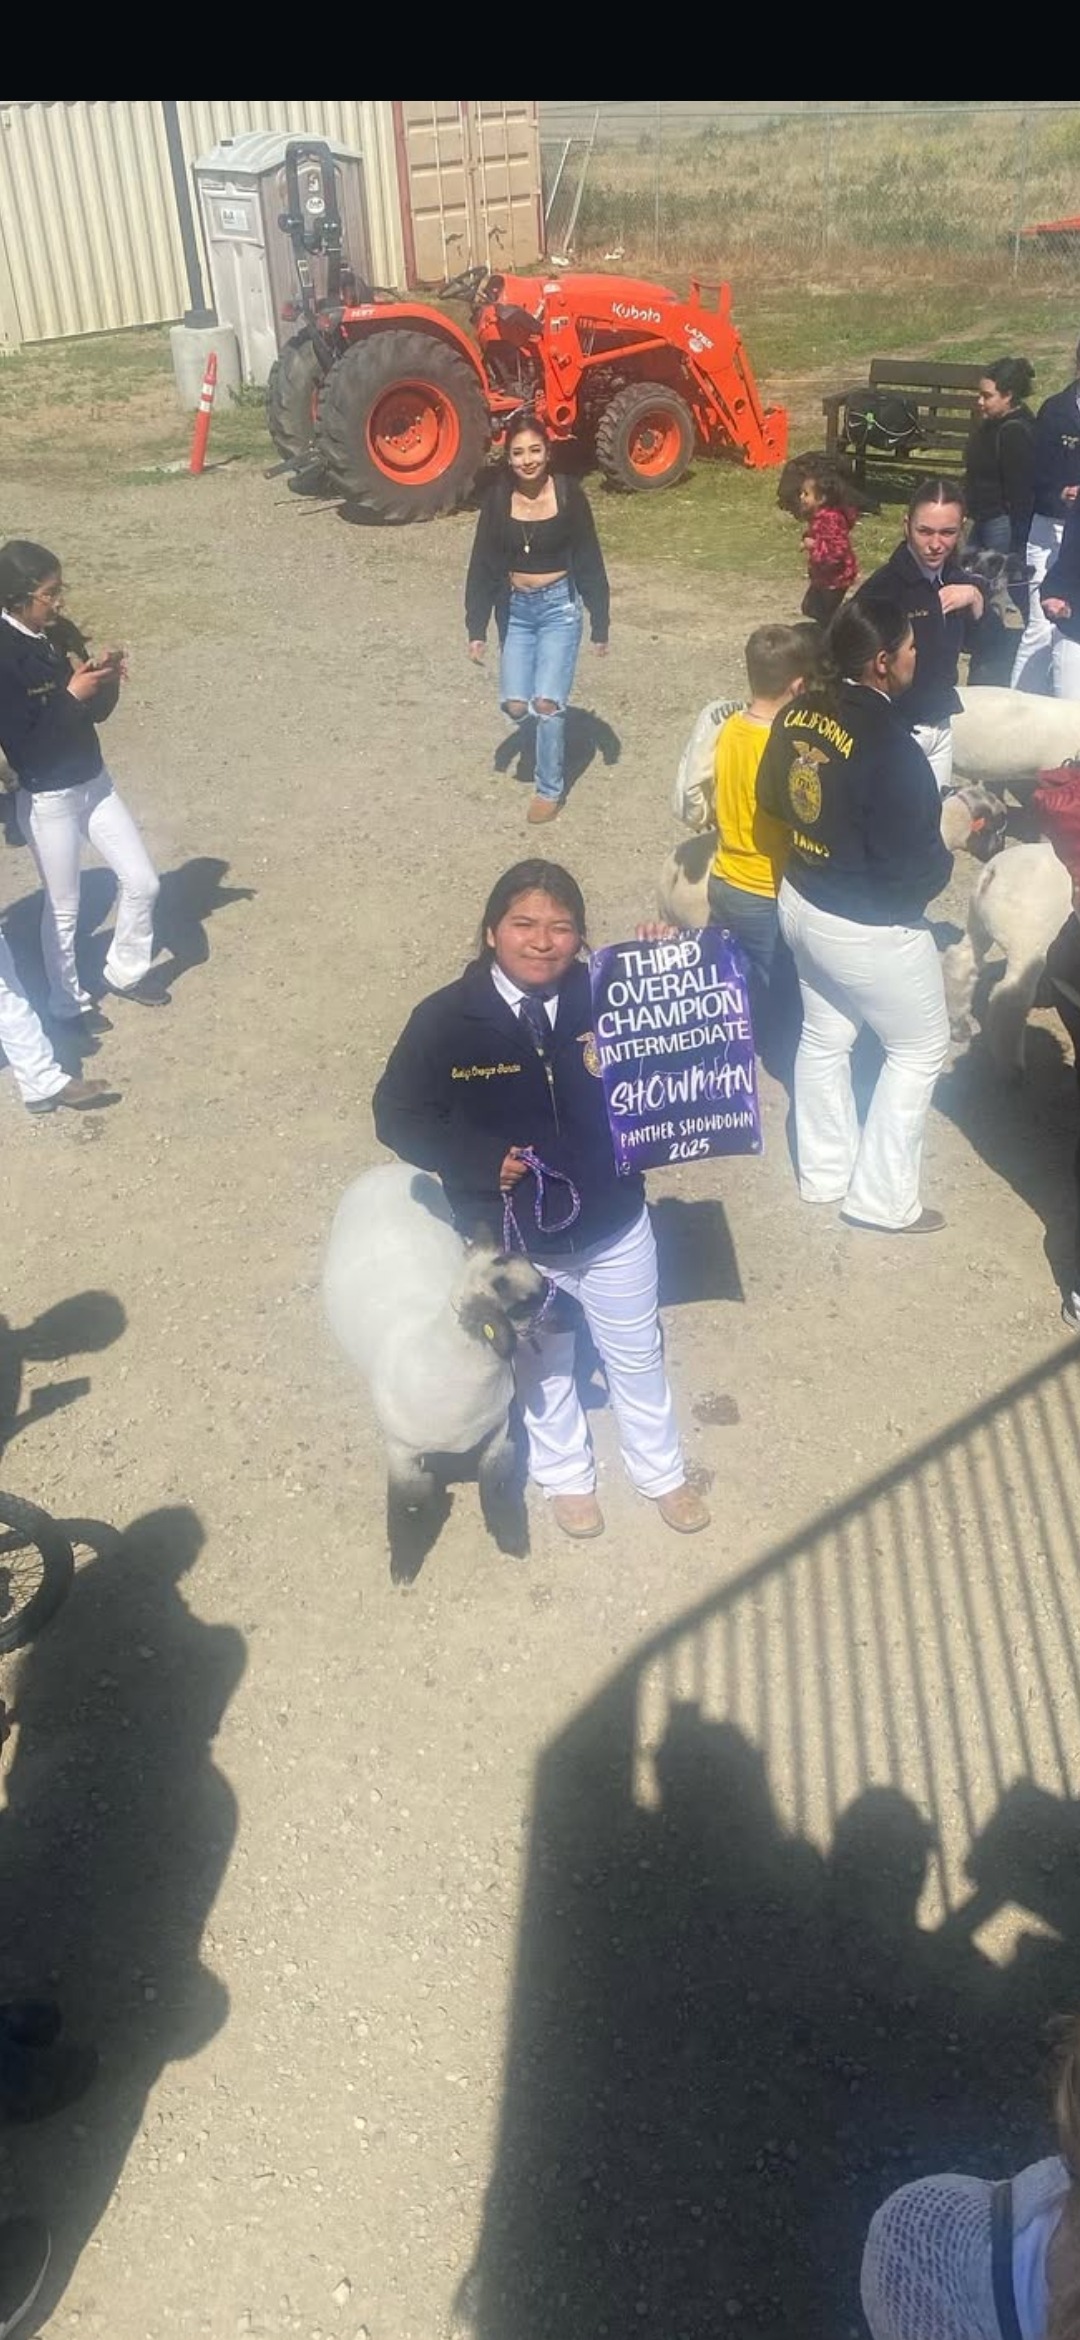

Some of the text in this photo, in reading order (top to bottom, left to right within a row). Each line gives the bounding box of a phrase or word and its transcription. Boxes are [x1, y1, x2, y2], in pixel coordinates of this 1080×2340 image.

[611, 302, 661, 323] Kubota
[784, 709, 855, 760] CALIFORNIA
[617, 940, 702, 978] THIRD
[607, 964, 728, 1007] OVERALL
[598, 988, 744, 1038] CHAMPION
[600, 1019, 752, 1069] INTERMEDIATE
[609, 1058, 755, 1117] SHOWMAN
[621, 1112, 755, 1149] PANTHER SHOWDOWN
[669, 1137, 710, 1160] 2025
